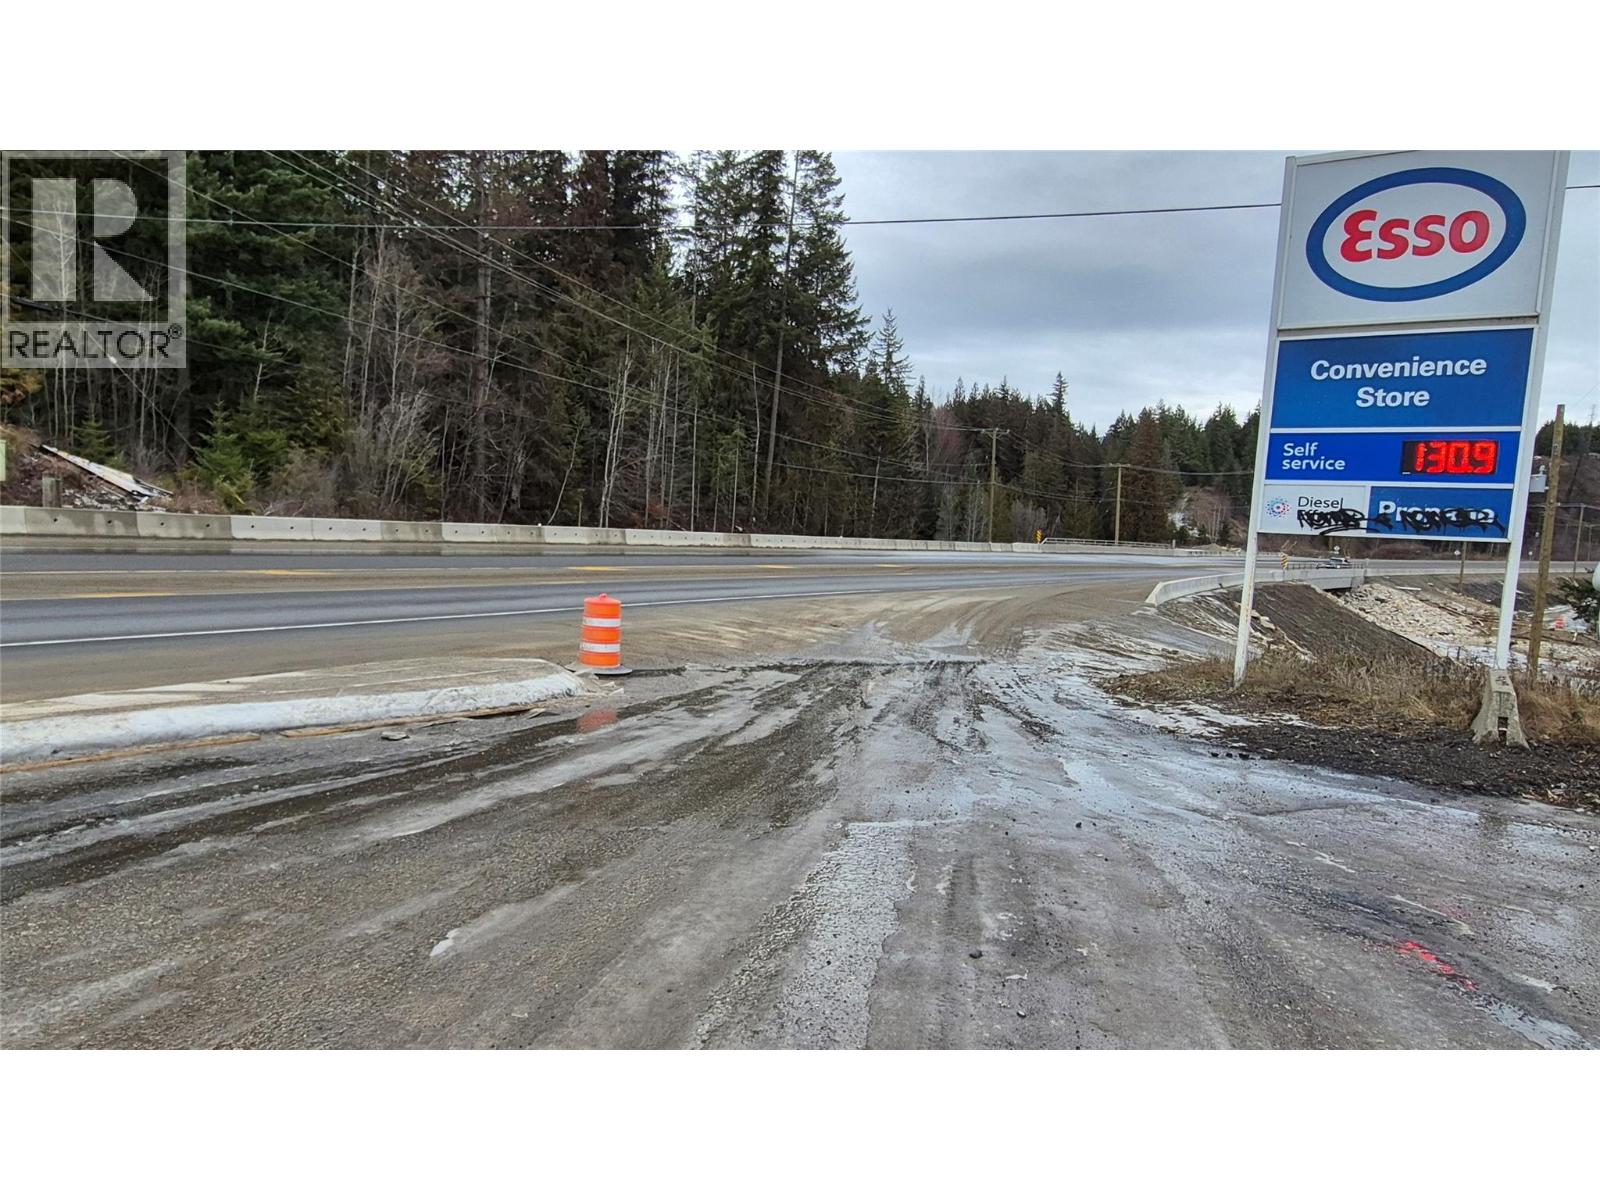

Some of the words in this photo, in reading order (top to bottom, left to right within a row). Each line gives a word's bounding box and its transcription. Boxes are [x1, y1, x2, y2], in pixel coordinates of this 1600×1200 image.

[1340, 209, 1491, 262] Esso
[1310, 356, 1488, 380] Convenience
[1356, 387, 1430, 408] Store
[1283, 442, 1318, 457] Self
[1282, 456, 1346, 471] service
[1297, 496, 1344, 510] Diesel
